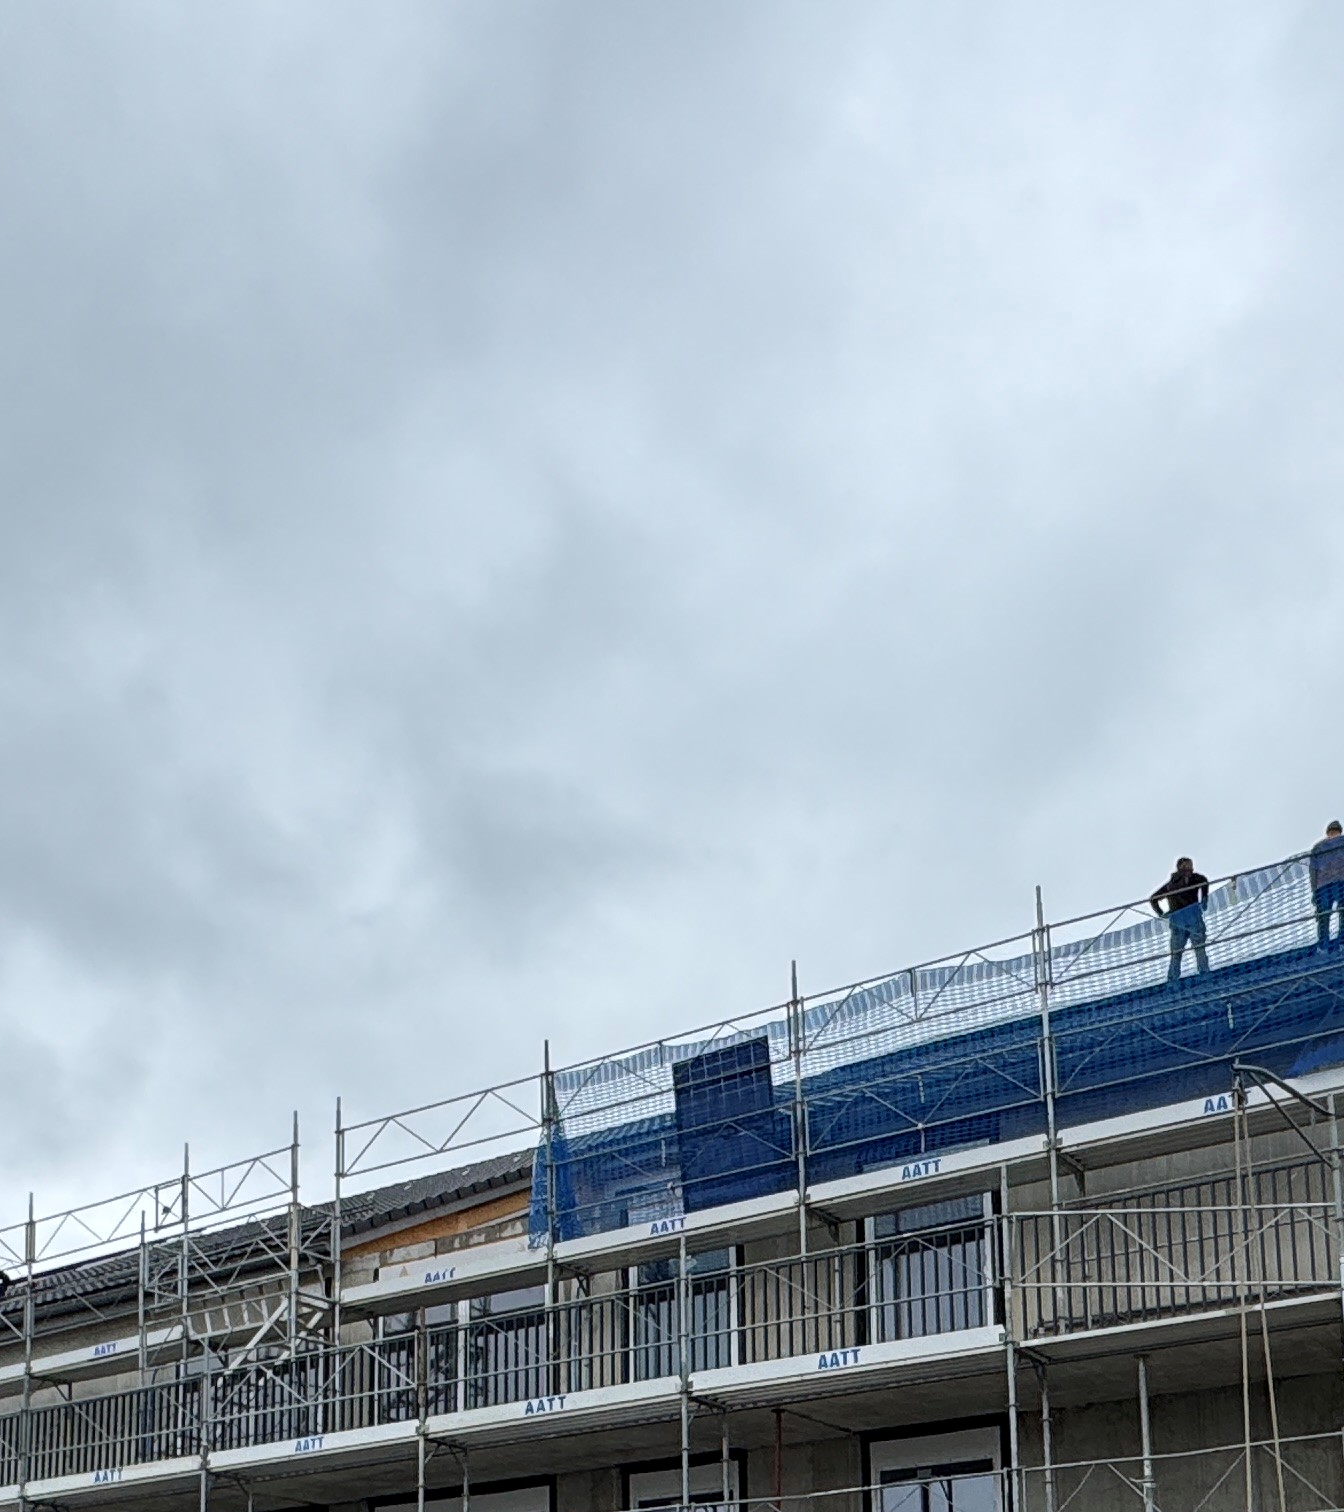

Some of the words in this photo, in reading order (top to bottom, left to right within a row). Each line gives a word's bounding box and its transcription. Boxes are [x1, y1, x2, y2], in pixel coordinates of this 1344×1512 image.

[901, 1158, 942, 1181] AATT
[649, 1216, 687, 1235] AATT
[94, 1342, 118, 1356] AATT
[817, 1348, 861, 1370] AATT
[525, 1395, 567, 1416] AATT
[294, 1436, 324, 1453] AATT
[94, 1468, 123, 1484] AATT
